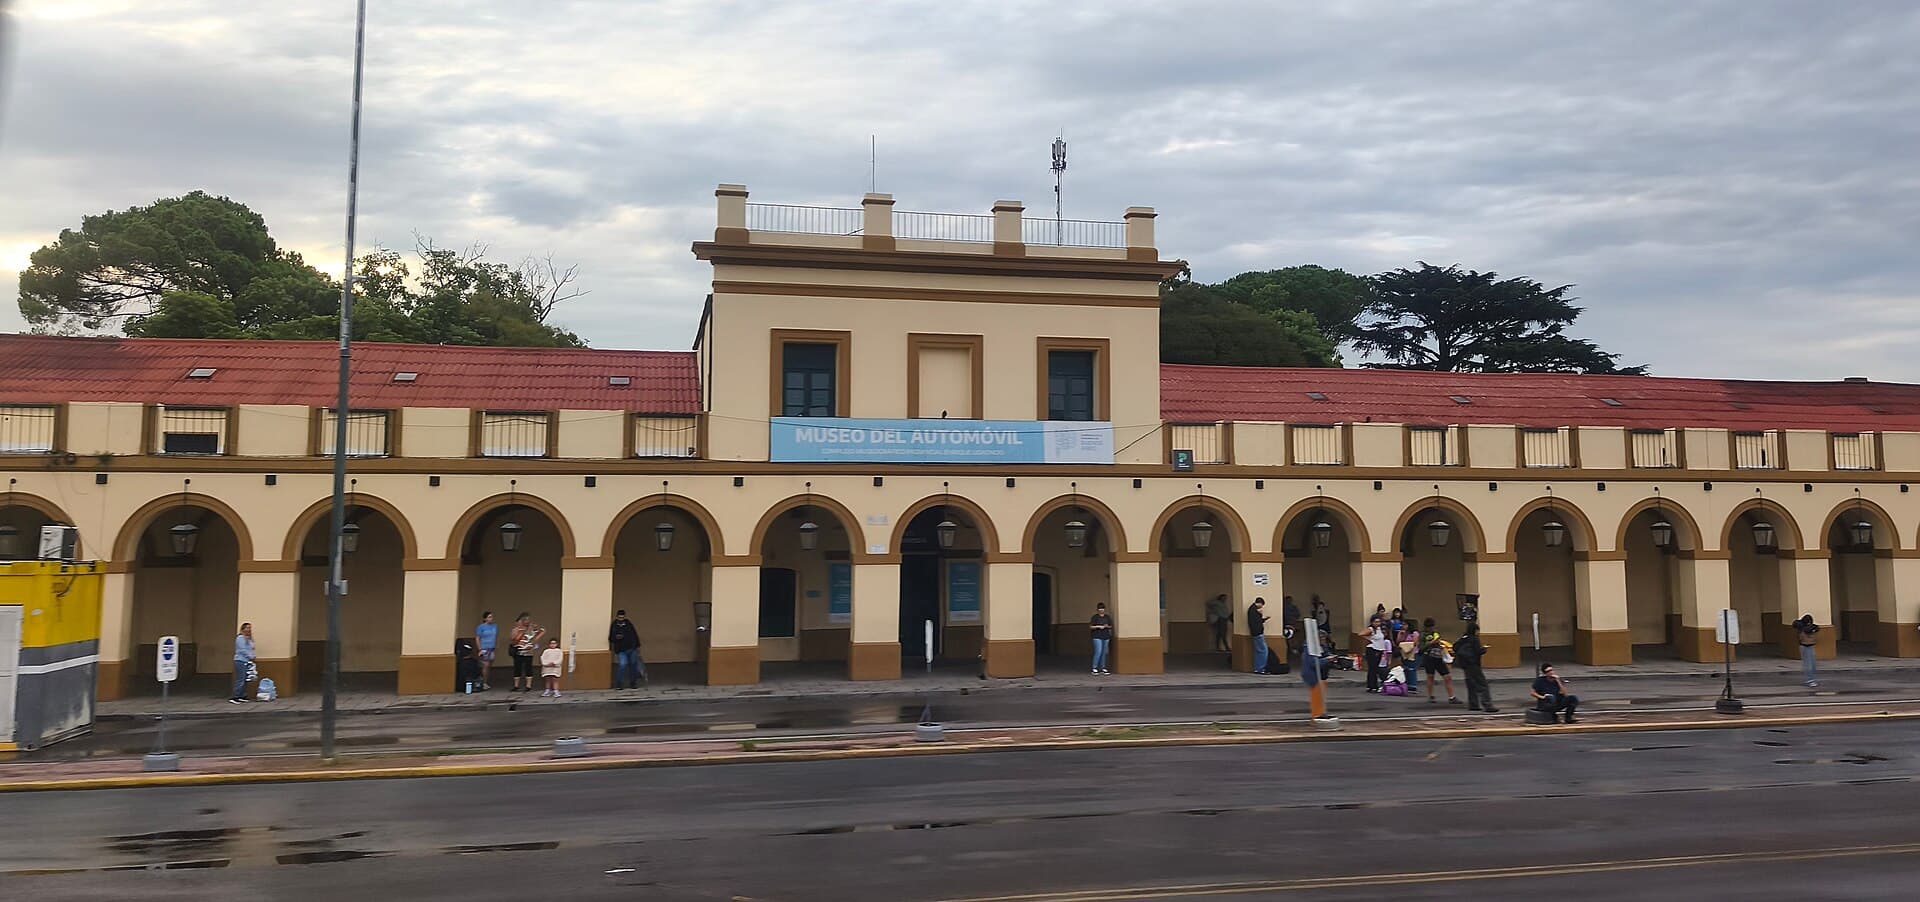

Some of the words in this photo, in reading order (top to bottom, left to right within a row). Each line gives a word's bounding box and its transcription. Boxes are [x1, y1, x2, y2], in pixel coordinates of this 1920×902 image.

[796, 428, 864, 444] MUSEO
[871, 430, 906, 444] DEL
[910, 427, 1023, 445] AUTOMÓVIL
